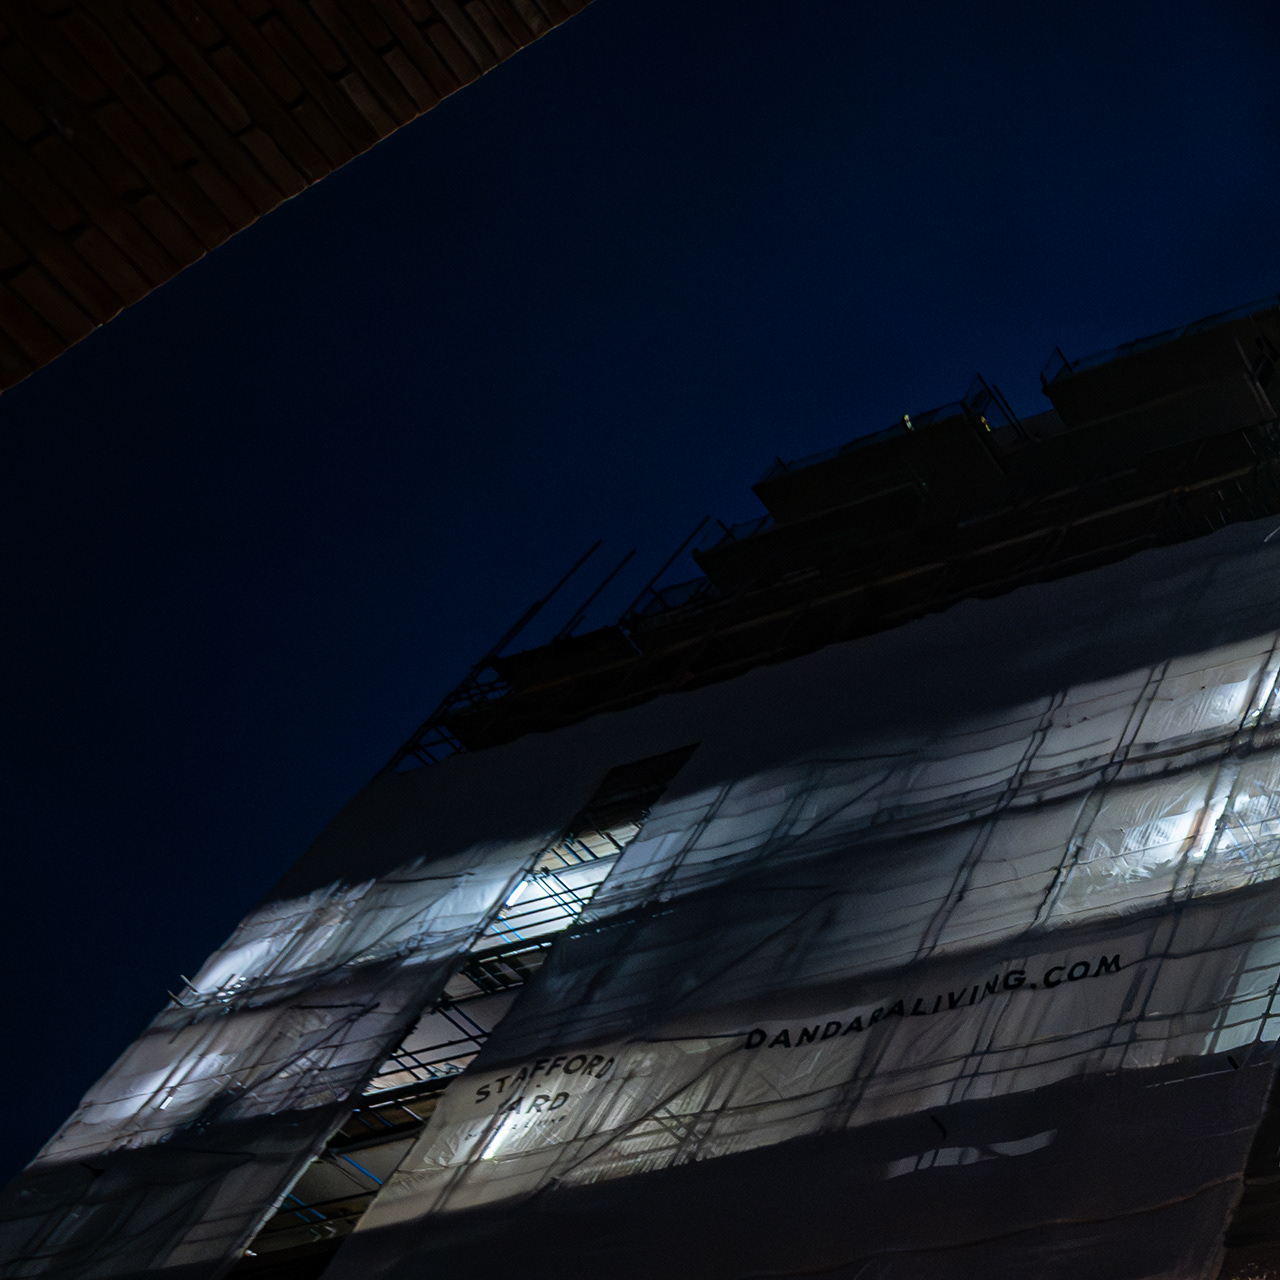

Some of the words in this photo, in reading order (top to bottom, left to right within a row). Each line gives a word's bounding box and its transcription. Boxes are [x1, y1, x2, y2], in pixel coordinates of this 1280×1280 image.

[744, 954, 1122, 1050] DANDARALIVING.COM
[475, 1054, 615, 1104] STAFFORD
[498, 1091, 570, 1114] ARD
